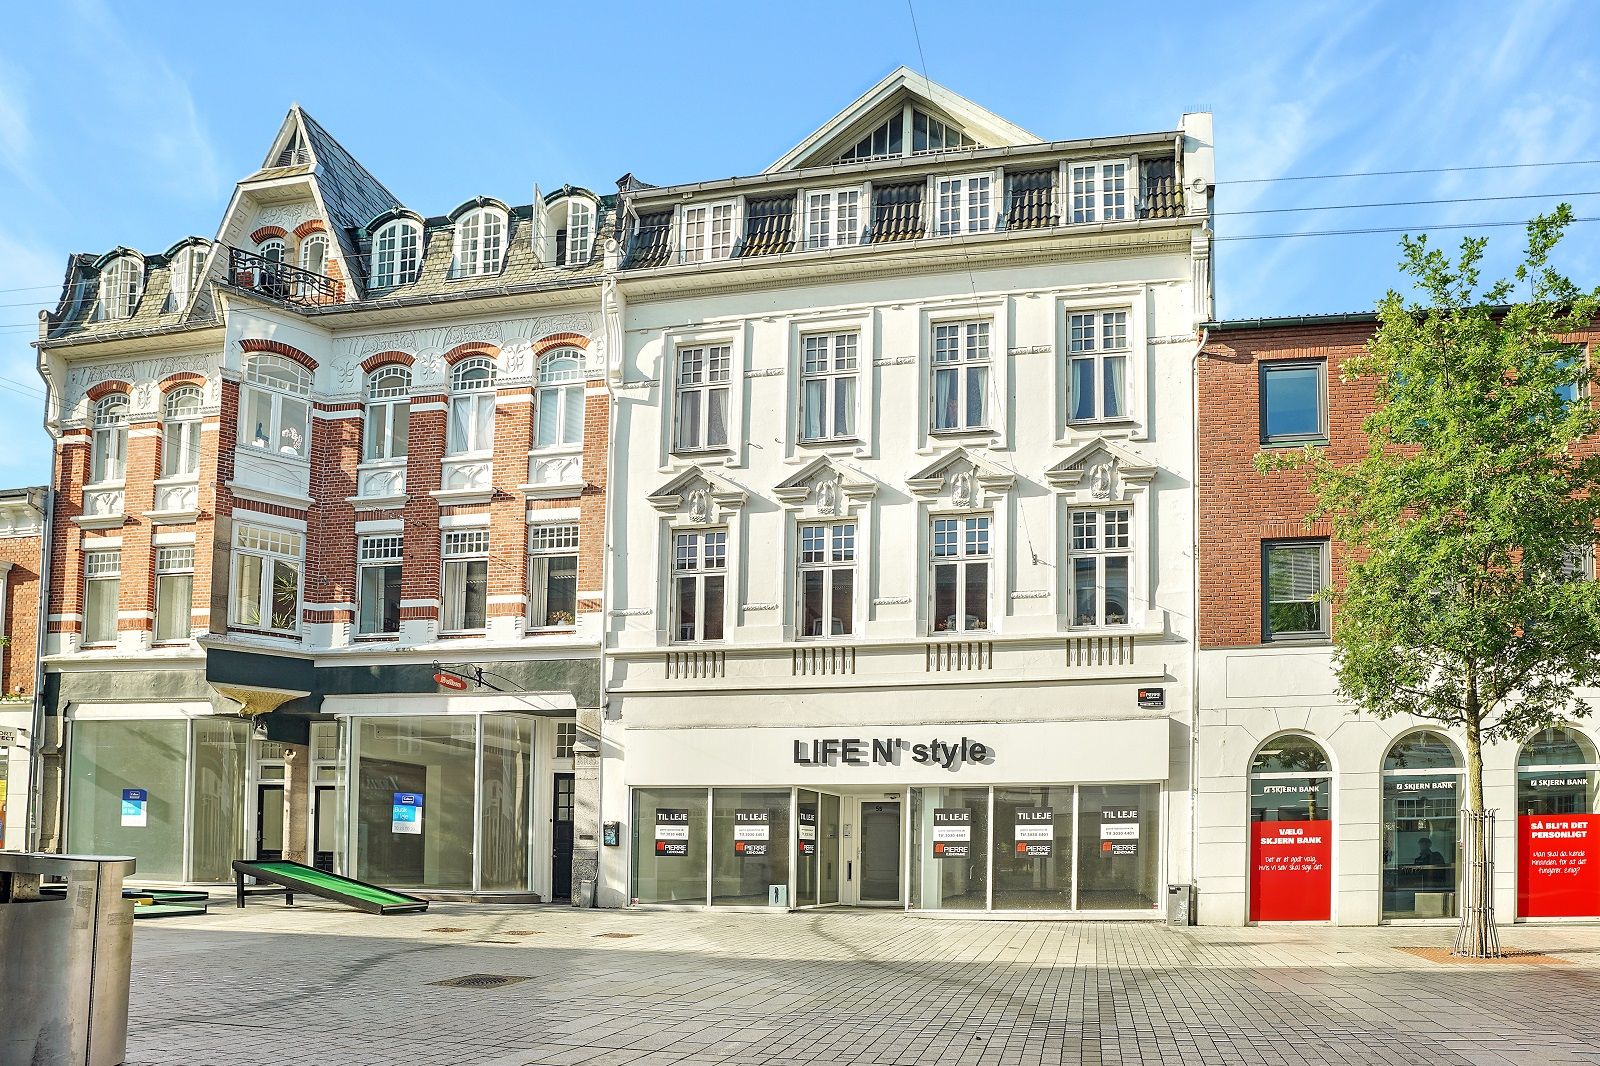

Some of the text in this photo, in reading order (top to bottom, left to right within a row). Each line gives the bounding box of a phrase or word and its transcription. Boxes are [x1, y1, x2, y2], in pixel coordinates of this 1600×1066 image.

[794, 736, 987, 768] LIFE N' style
[1271, 785, 1320, 794] SKJERN BANK
[657, 813, 688, 821] TIL LEJE
[736, 813, 768, 821] TIL LEJE
[935, 813, 970, 821] TIL LEJE
[1017, 812, 1052, 820] TIL LEJE
[1102, 810, 1138, 819] TIL LEJE
[1531, 821, 1543, 830] SÅ
[1570, 821, 1588, 829] DET
[1531, 830, 1588, 839] PERSONLIGT
[1260, 836, 1322, 845] SKJERN BANK
